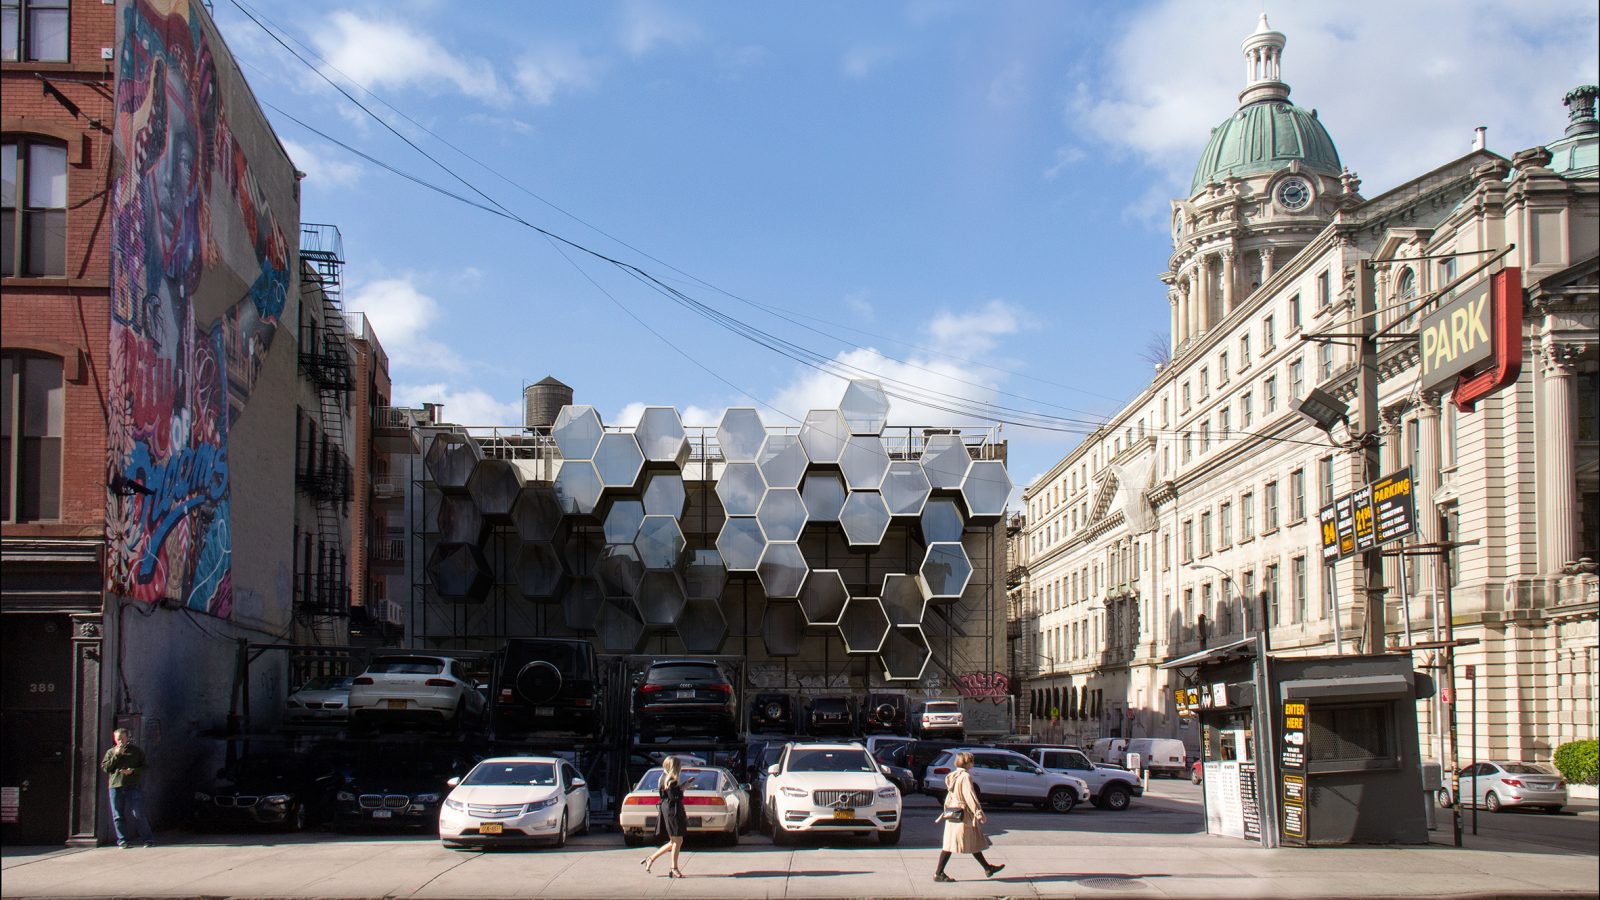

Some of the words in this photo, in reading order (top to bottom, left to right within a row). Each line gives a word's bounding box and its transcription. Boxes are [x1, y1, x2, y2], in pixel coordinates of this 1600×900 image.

[1423, 292, 1489, 376] PARK
[1374, 478, 1409, 503] PARKING
[1321, 508, 1334, 522] OPEN
[1324, 521, 1336, 545] 24
[30, 683, 55, 692] 389
[1285, 704, 1305, 715] ENTER
[1286, 717, 1303, 729] HERE
